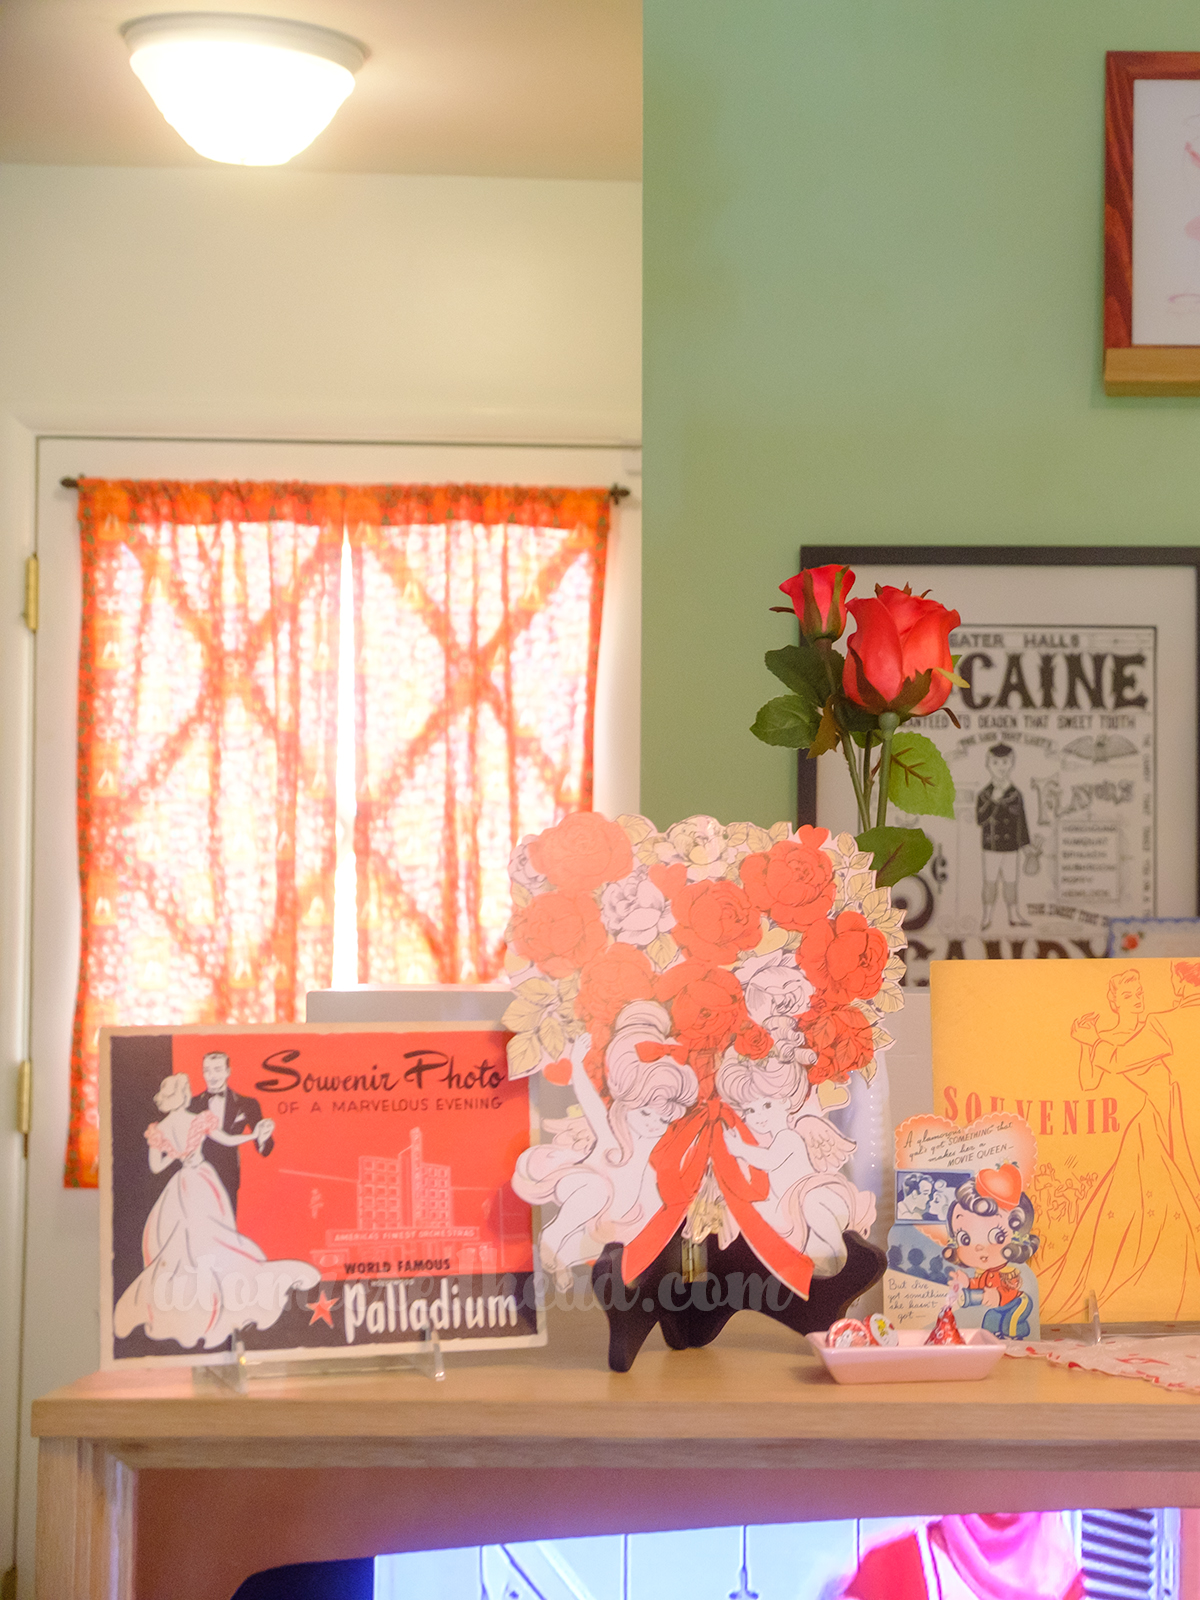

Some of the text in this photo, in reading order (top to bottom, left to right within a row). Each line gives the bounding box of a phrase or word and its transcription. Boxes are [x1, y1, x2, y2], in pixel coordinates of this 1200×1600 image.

[957, 652, 1148, 710] CAINE
[978, 714, 1018, 730] DEADEN
[1024, 714, 1049, 730] THAT
[1057, 714, 1094, 730] SWEET
[1099, 714, 1137, 729] TOOTH
[254, 1049, 506, 1093] Souvenir Photo
[277, 1096, 503, 1115] OF A MARVELOUS EVENING
[903, 1130, 914, 1149] A
[931, 1140, 945, 1155] got
[948, 1124, 995, 1147] SOMETHING
[997, 1121, 1014, 1132] that
[928, 1148, 956, 1163] makes
[959, 1142, 976, 1155] her
[947, 1152, 974, 1168] MOVIE
[382, 1230, 417, 1240] FINEST
[344, 1258, 451, 1275] WORLD FAMOUS
[888, 1278, 907, 1291] But
[888, 1293, 901, 1303] got
[889, 1301, 904, 1310] she
[344, 1277, 518, 1344] Palladium
[897, 1311, 914, 1325] got
